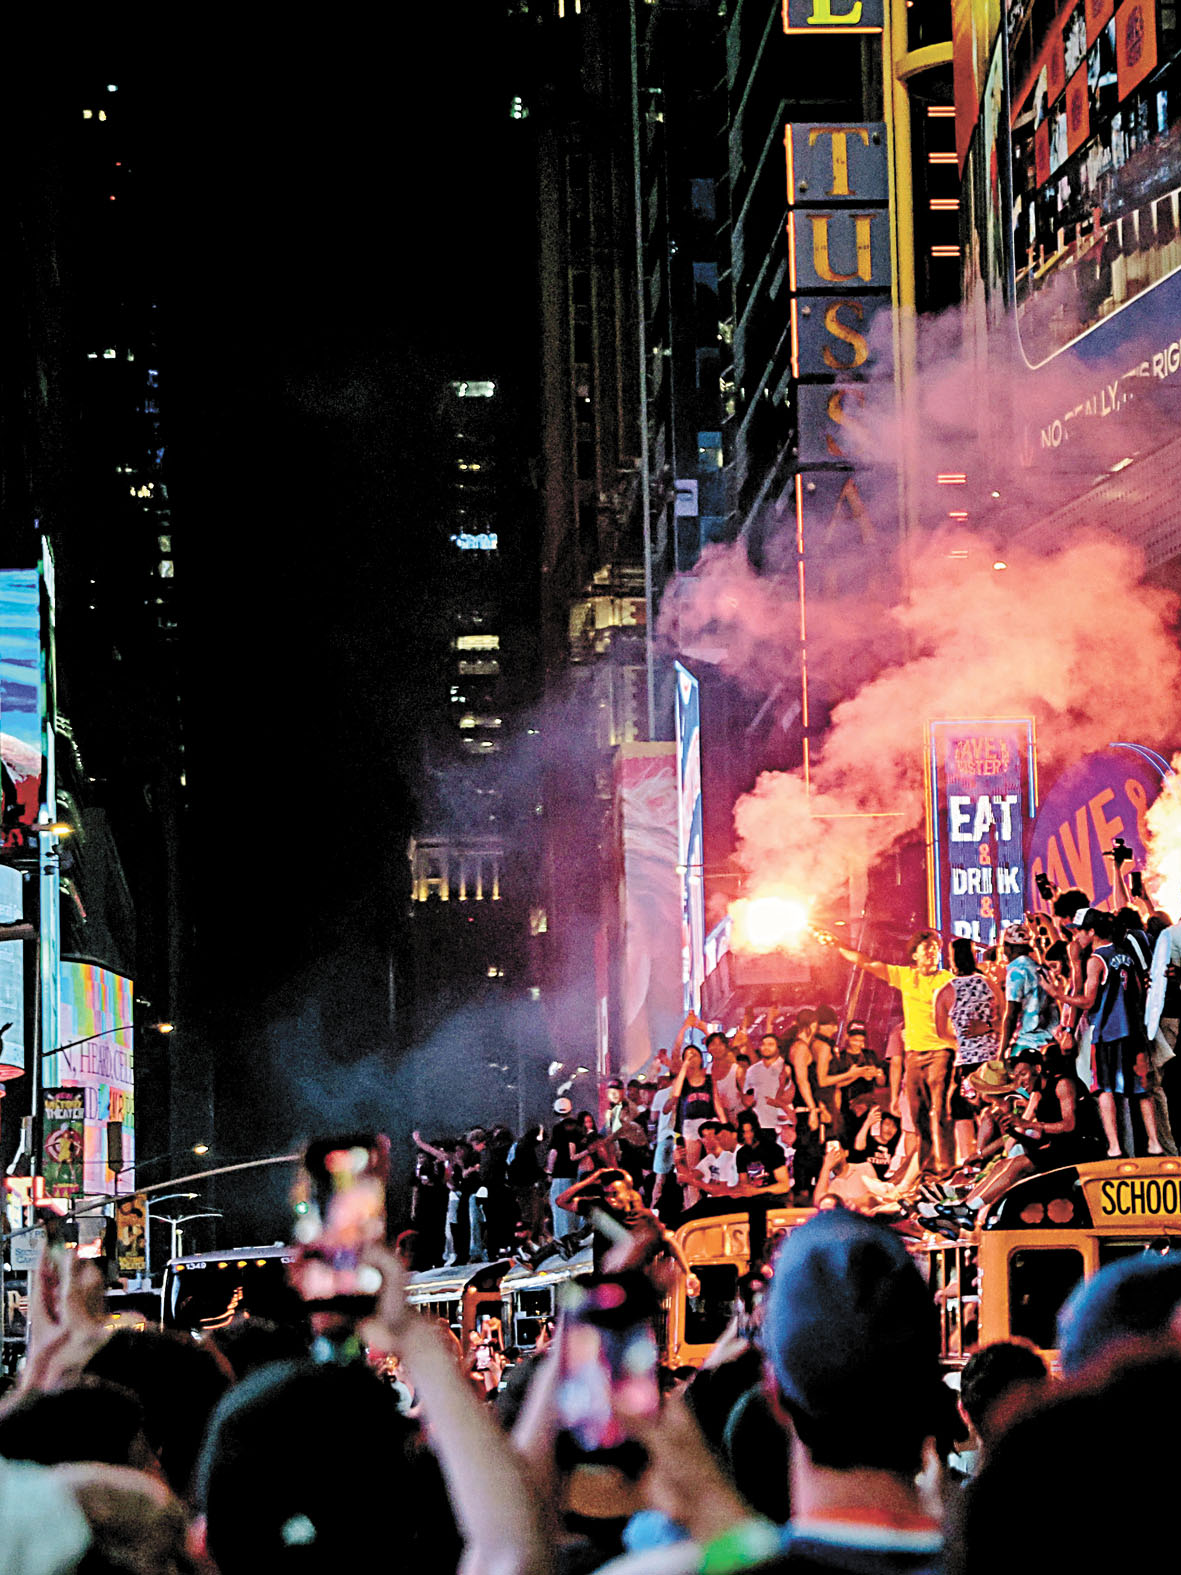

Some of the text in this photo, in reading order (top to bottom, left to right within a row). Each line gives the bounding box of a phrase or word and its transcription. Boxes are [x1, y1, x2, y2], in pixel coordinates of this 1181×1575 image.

[950, 795, 1018, 842] EAT
[979, 843, 991, 866] &
[980, 896, 994, 919] &
